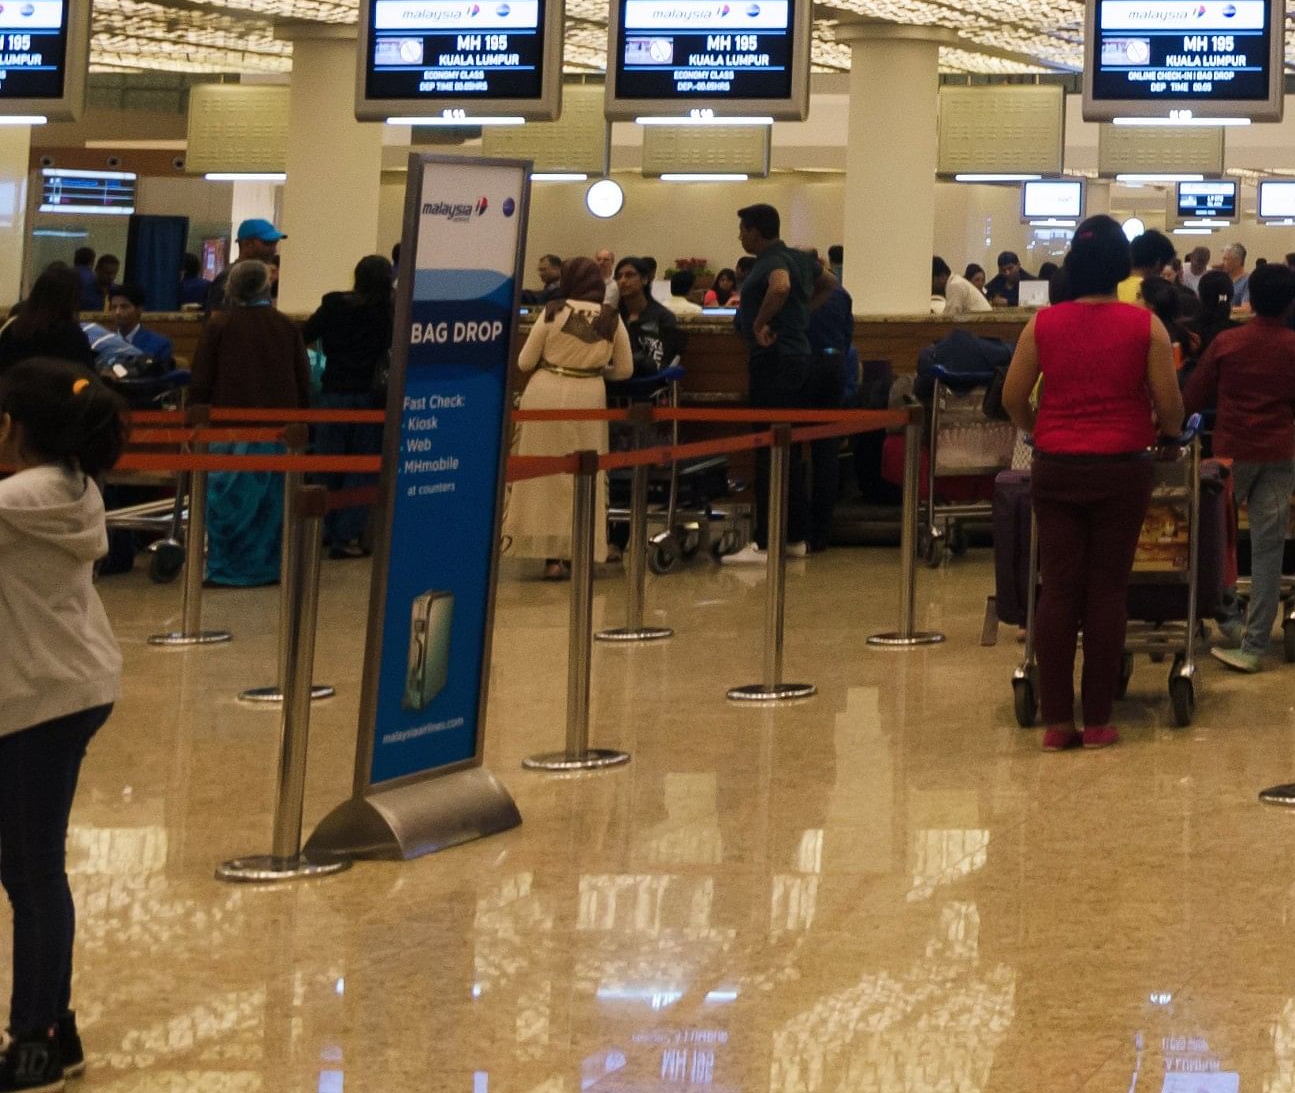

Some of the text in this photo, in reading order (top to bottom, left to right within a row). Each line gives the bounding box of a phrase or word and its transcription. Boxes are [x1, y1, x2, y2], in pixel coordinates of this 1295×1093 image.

[402, 7, 462, 21] malaysia
[652, 8, 712, 21] malaysia
[1128, 8, 1188, 21] malaysia
[8, 35, 31, 51] 195
[457, 35, 508, 51] MH 195
[707, 35, 758, 51] MH 195
[1183, 36, 1235, 52] MH 195
[439, 54, 520, 66] KUALA LUMPUR
[689, 54, 770, 66] KUALA LUMPUR
[1166, 55, 1247, 67] KUALA LUMPUR
[423, 70, 485, 80] ECONOMY CLASS
[673, 70, 735, 80] ECONOMY CLASS
[1128, 71, 1156, 81] ONLINE
[1157, 71, 1193, 81] CHECK-IN
[1213, 71, 1235, 81] DROP
[1150, 82, 1167, 92] DEP
[1170, 82, 1189, 92] TIME
[422, 202, 473, 221] malaysia
[410, 320, 503, 345] BAG DROP
[403, 393, 466, 412] Fast Check:
[408, 415, 439, 432] Kiosk
[406, 437, 432, 453] Web
[404, 455, 460, 475] MHmobile
[407, 482, 456, 497] at counters
